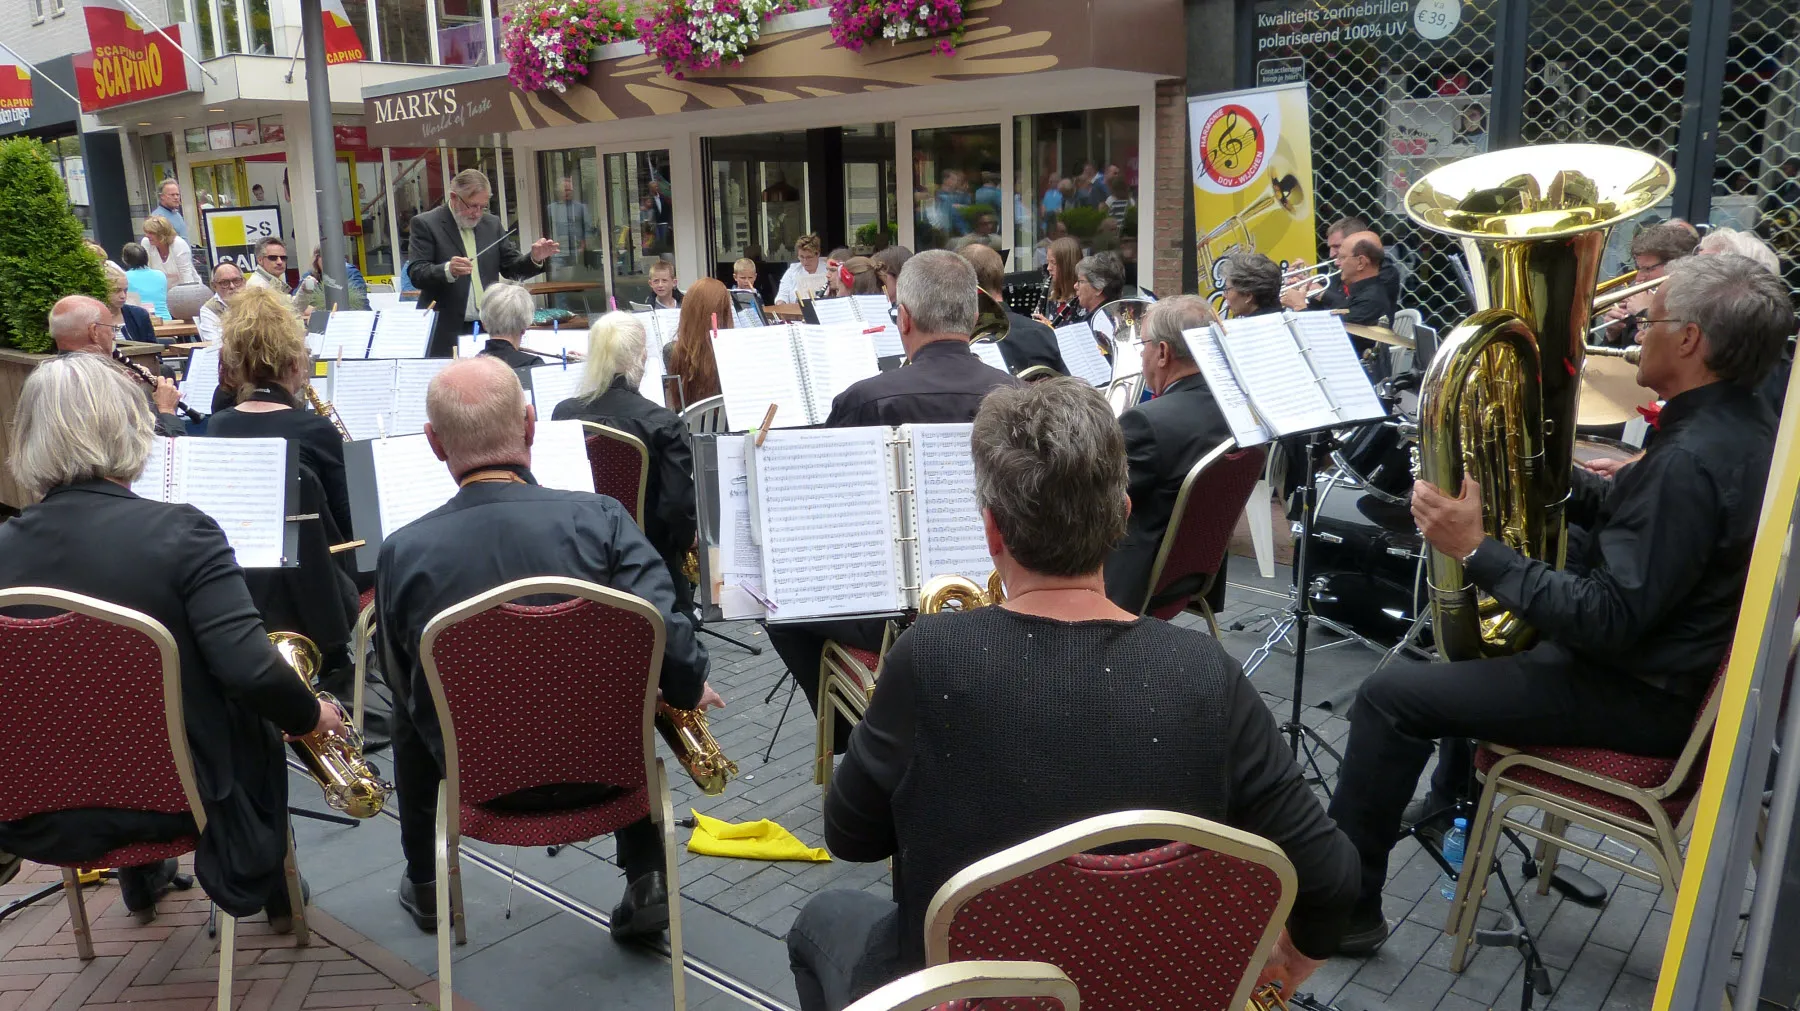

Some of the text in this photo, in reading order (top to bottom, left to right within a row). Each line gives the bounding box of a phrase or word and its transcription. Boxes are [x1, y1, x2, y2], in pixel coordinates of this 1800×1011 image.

[1258, 0, 1409, 28] Kwaliteits zonnebrillen
[95, 45, 144, 60] SCAPINO
[1258, 21, 1407, 51] polariserend 100% UV
[93, 42, 163, 99] SCAPINO
[326, 48, 363, 64] CAPINO
[373, 88, 457, 124] MARK'S
[421, 97, 492, 138] World of Taste
[1200, 108, 1225, 148] HARMONIE
[1217, 176, 1233, 186] DOV
[1237, 151, 1264, 184] WIJCHEN
